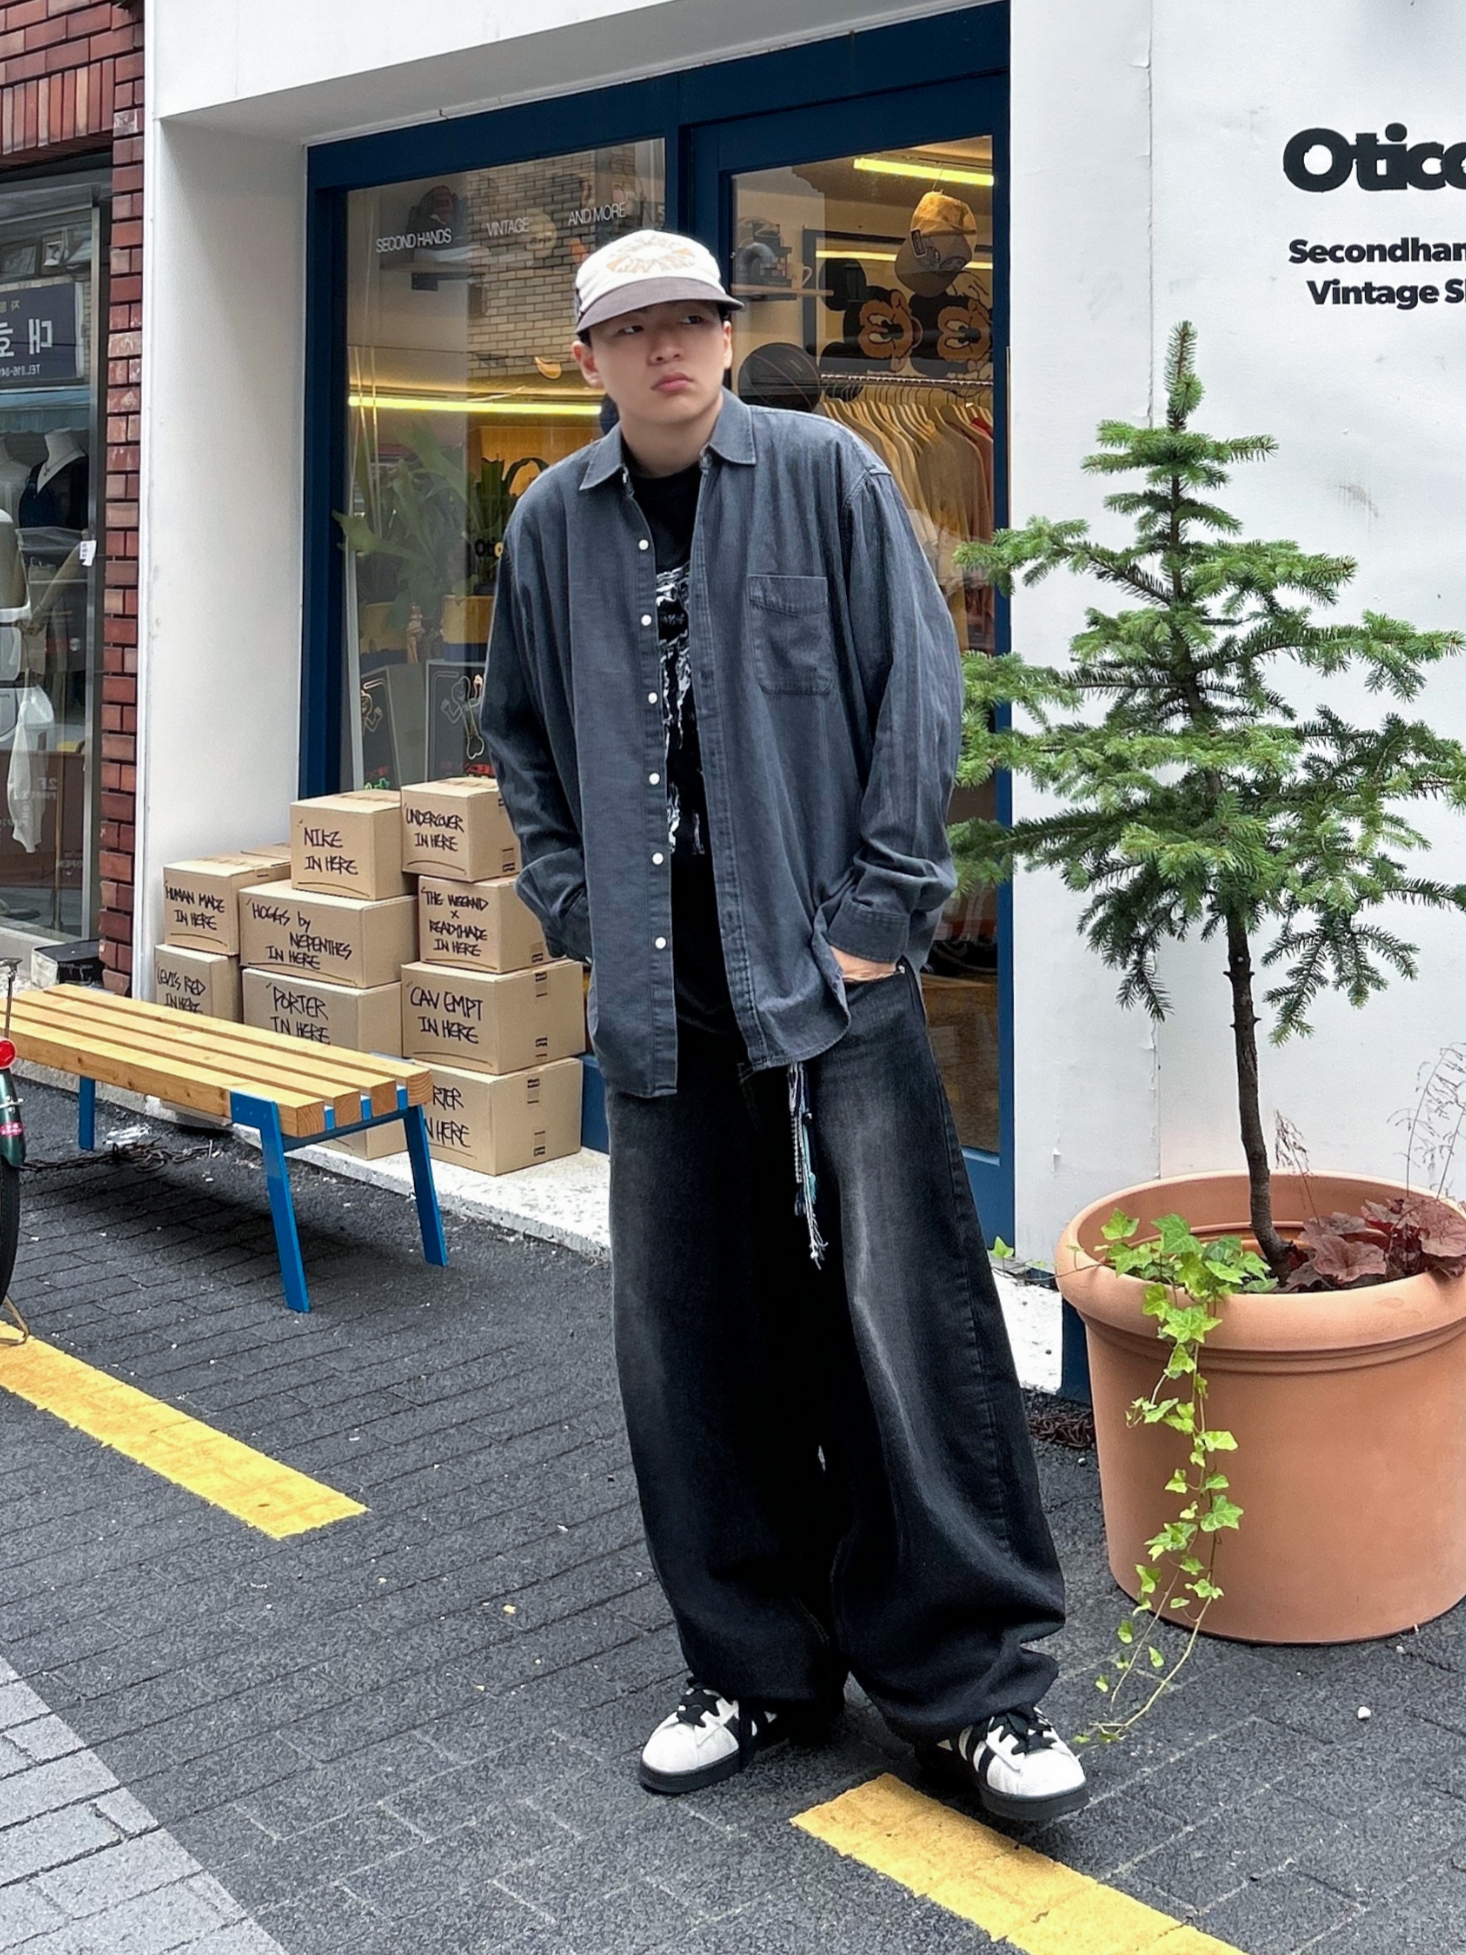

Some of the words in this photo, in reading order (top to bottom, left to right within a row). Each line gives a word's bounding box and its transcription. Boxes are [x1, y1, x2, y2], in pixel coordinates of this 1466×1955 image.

[568, 208, 592, 226] AND
[593, 202, 626, 222] MORE
[486, 217, 530, 237] VINTAGE
[376, 233, 416, 253] SECOND
[417, 228, 452, 247] HANDS
[1306, 278, 1439, 310] Vintage
[1445, 278, 1466, 304] S
[406, 807, 464, 833] UNDERCOVER
[304, 827, 343, 848] NIKE
[414, 833, 429, 848] IN
[430, 834, 458, 852] HERE
[304, 855, 322, 873] IN
[325, 855, 358, 875] HERE
[165, 886, 195, 905] HUMAN
[198, 893, 225, 913] MADE
[421, 889, 444, 906] THE
[174, 909, 189, 926] IN
[190, 912, 218, 931] HERE
[252, 902, 291, 926] HOGGS
[297, 911, 311, 933] by
[266, 945, 285, 962] IN
[288, 950, 320, 970] HERE
[289, 931, 352, 960] NEPENTHES
[433, 938, 450, 953] IN
[451, 941, 482, 957] HERE
[164, 992, 178, 1010] IN
[273, 985, 329, 1020] PORTER
[410, 986, 440, 1010] CAV
[443, 991, 483, 1021] EMPT
[270, 1016, 291, 1035] IN
[295, 1021, 331, 1045] HERE
[418, 1016, 439, 1037] IN
[441, 1019, 479, 1045] HERE
[432, 1084, 465, 1111] RTER
[424, 1116, 434, 1139] N
[436, 1119, 471, 1148] HERE
